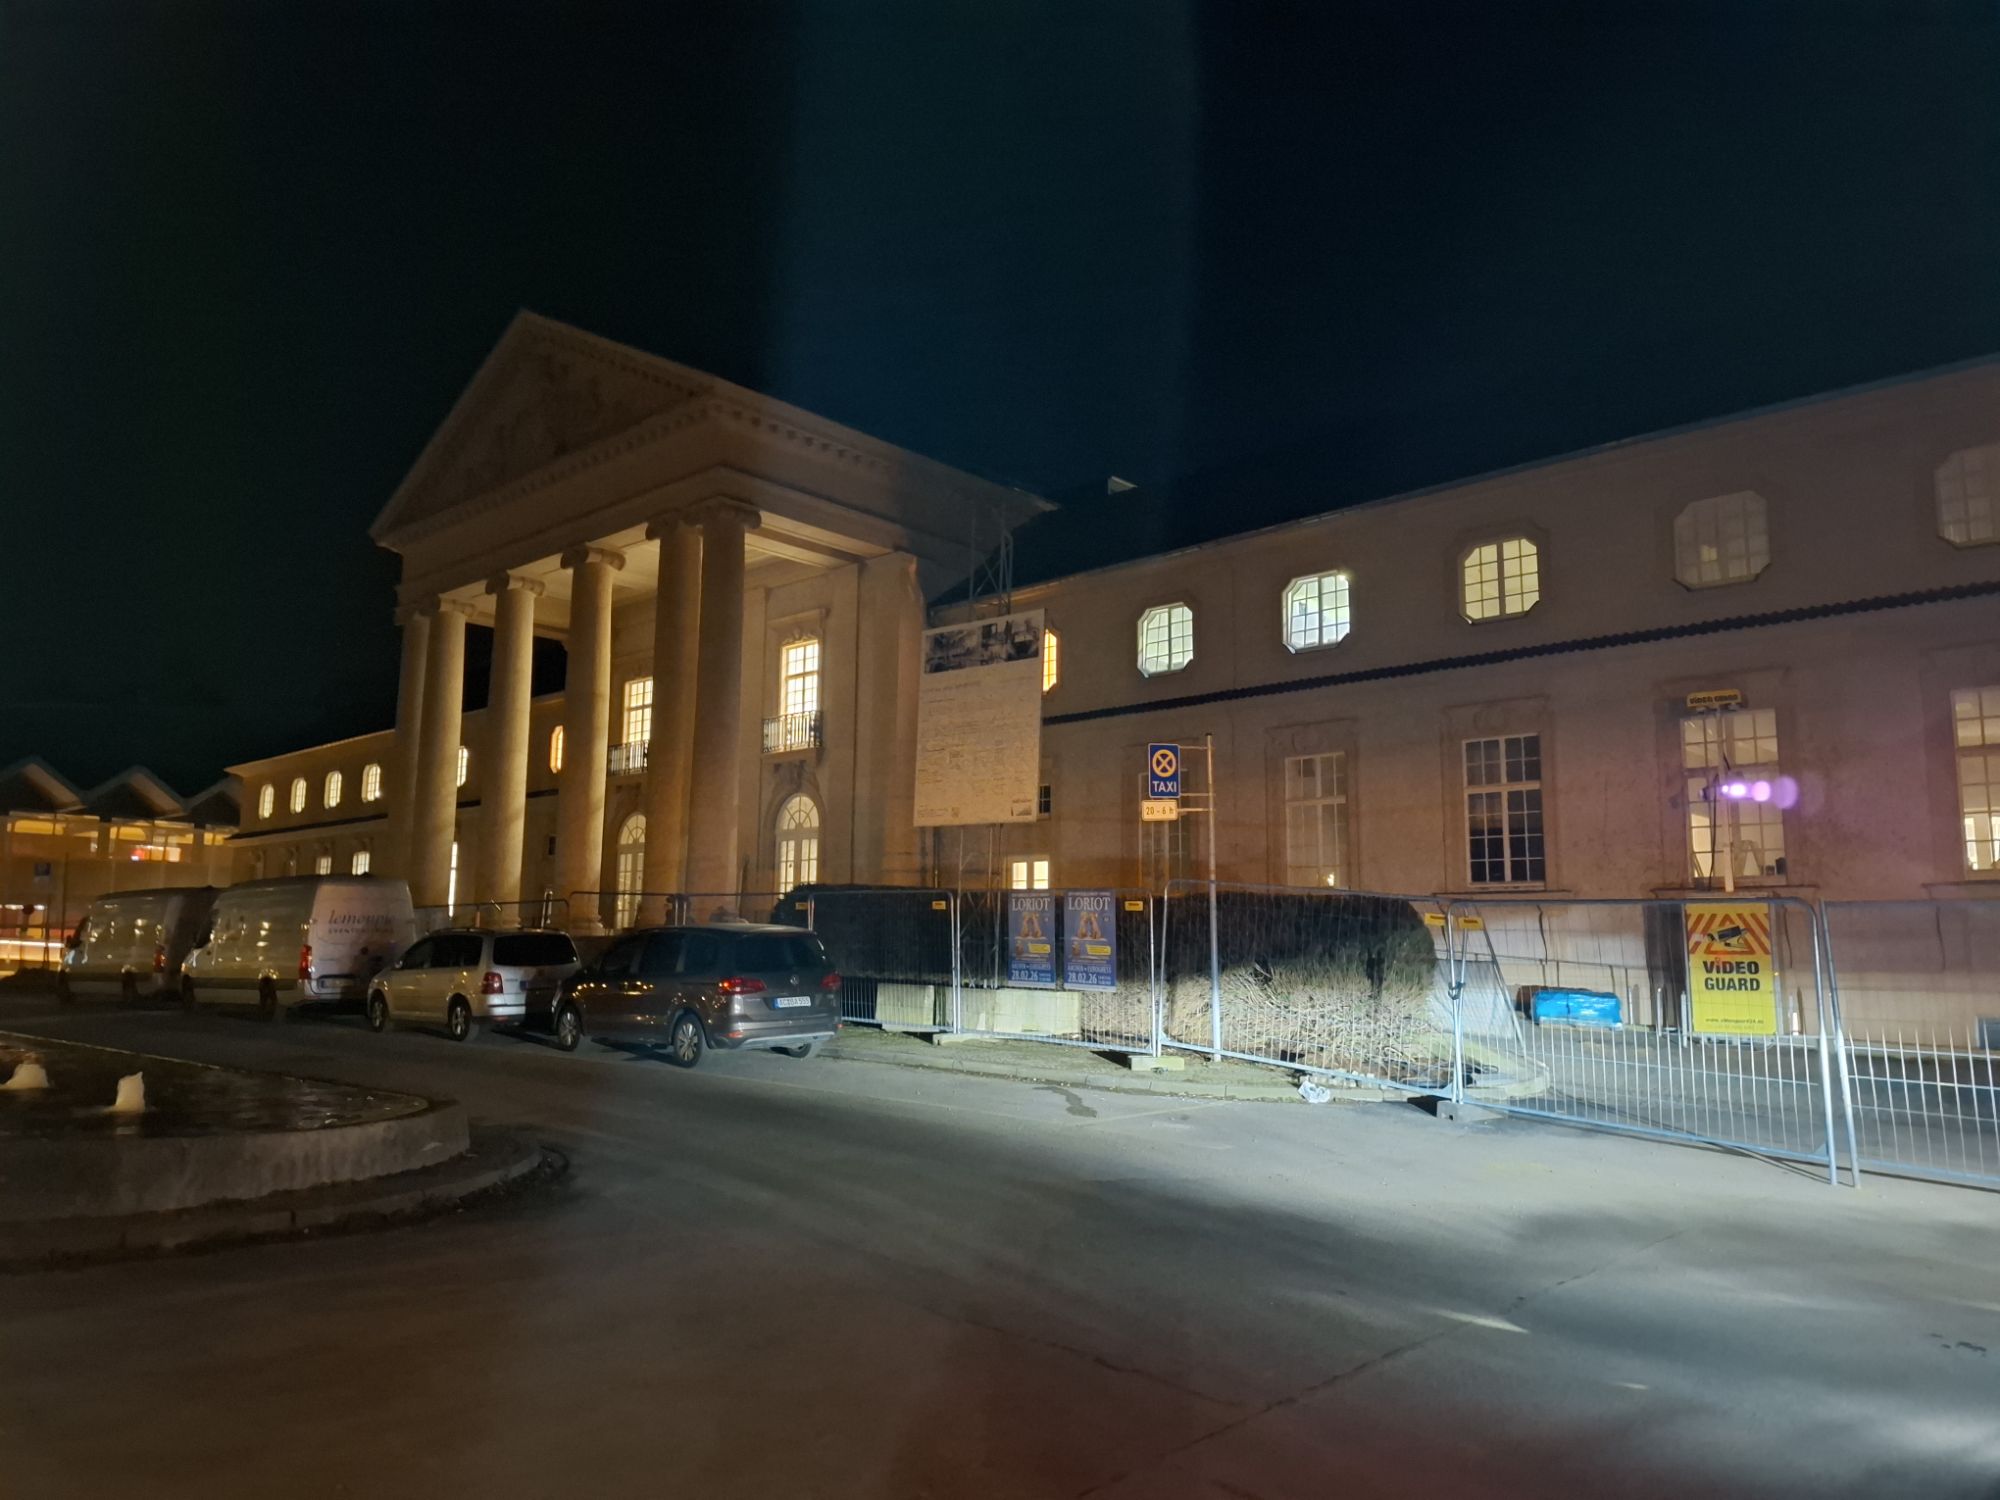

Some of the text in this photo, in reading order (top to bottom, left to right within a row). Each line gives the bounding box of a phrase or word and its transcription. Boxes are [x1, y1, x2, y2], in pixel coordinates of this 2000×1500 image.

[1152, 781, 1177, 792] TAXI
[1146, 806, 1155, 815] 20
[1162, 806, 1167, 815] 6
[1011, 897, 1051, 911] LORIOT
[1068, 896, 1111, 911] LORIOT
[1068, 972, 1098, 984] 28.02.26
[1704, 977, 1761, 991] GUARD
